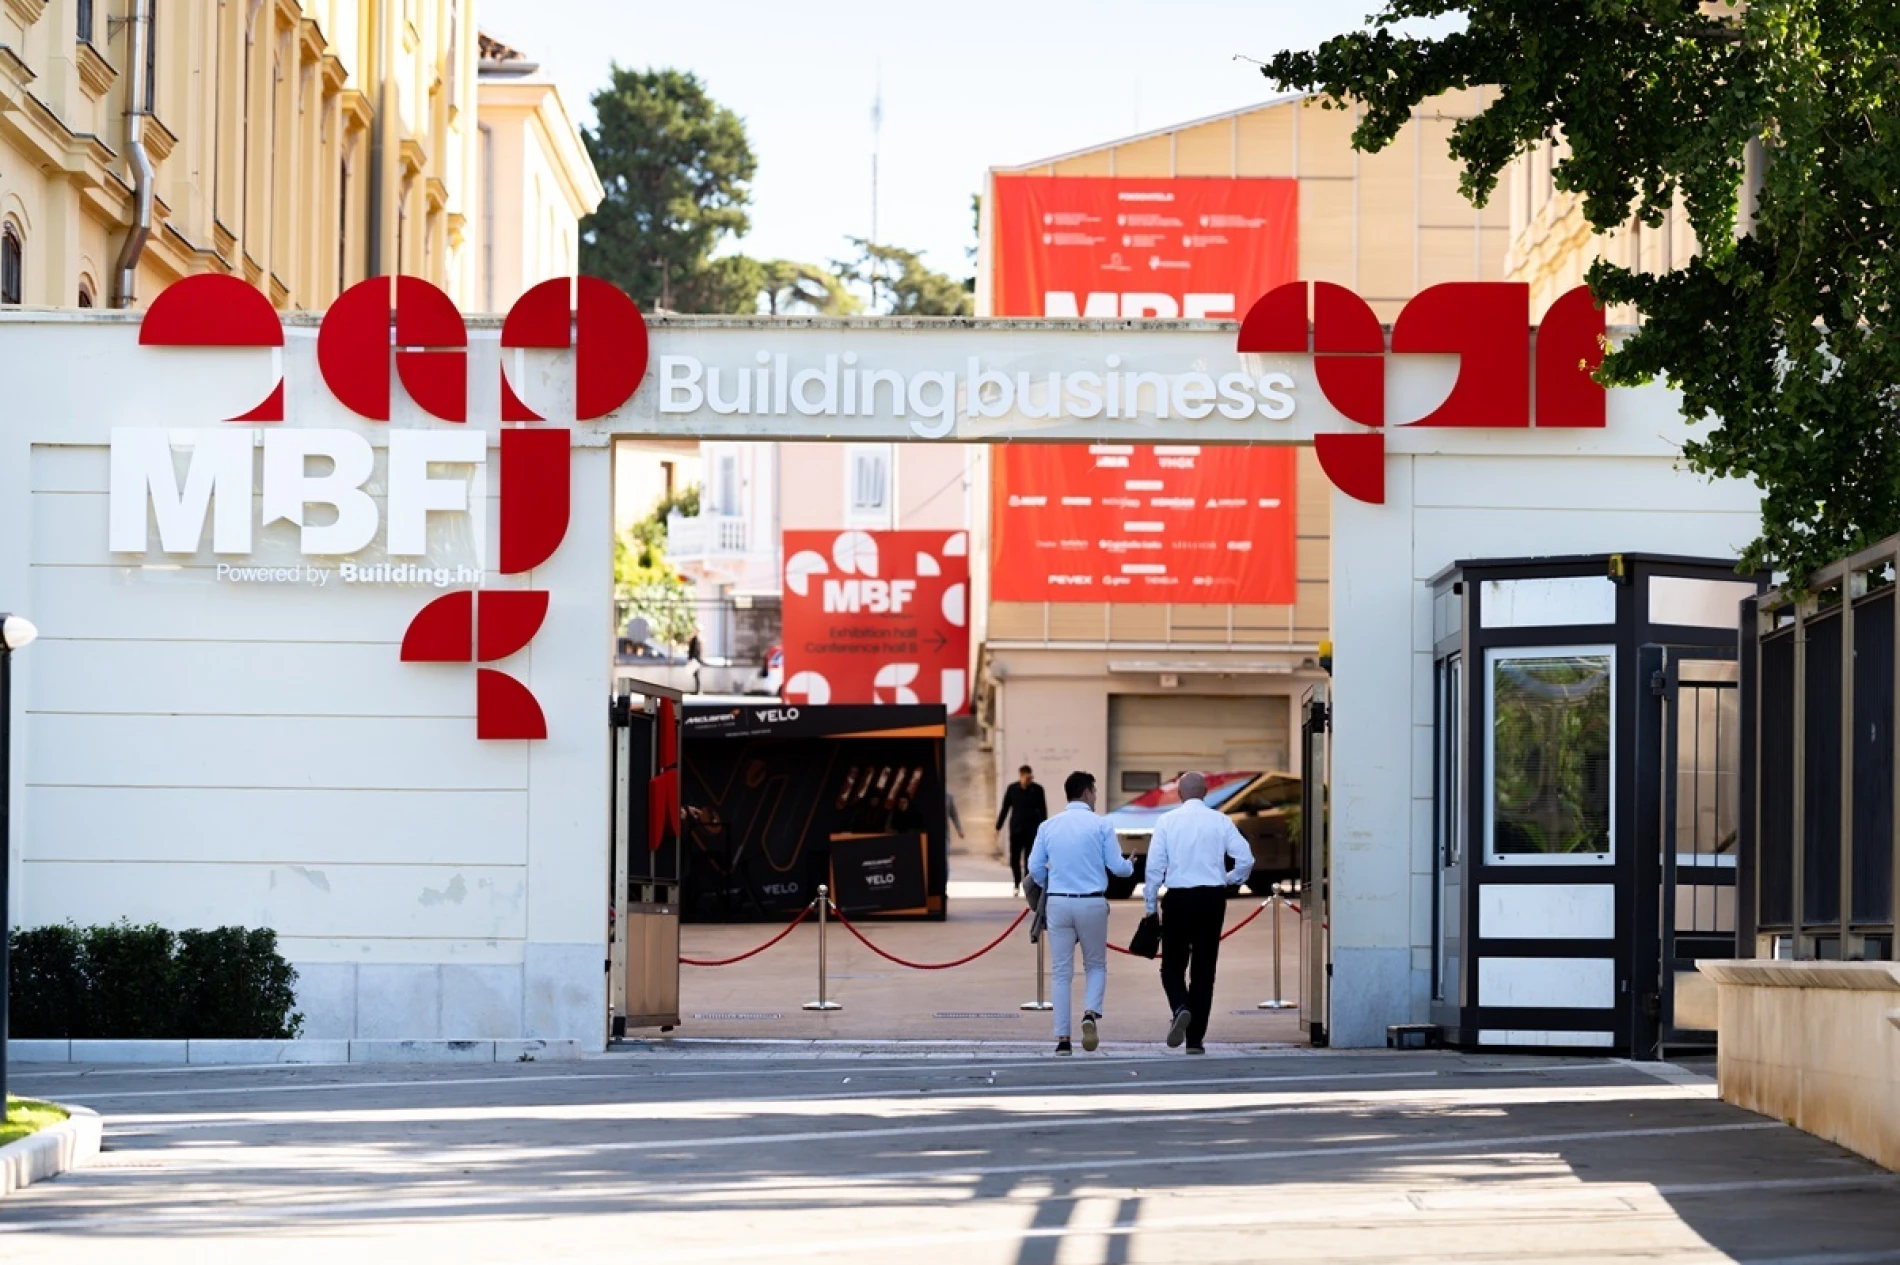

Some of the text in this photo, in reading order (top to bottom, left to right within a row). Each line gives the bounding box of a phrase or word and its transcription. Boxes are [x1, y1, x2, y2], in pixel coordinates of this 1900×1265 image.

[109, 427, 487, 555] MBF
[216, 563, 483, 588] Powered by Building.hr
[823, 580, 917, 613] MBF
[894, 627, 917, 638] hall
[755, 707, 799, 722] VELO
[865, 873, 895, 885] VELO
[762, 882, 798, 895] VELO
